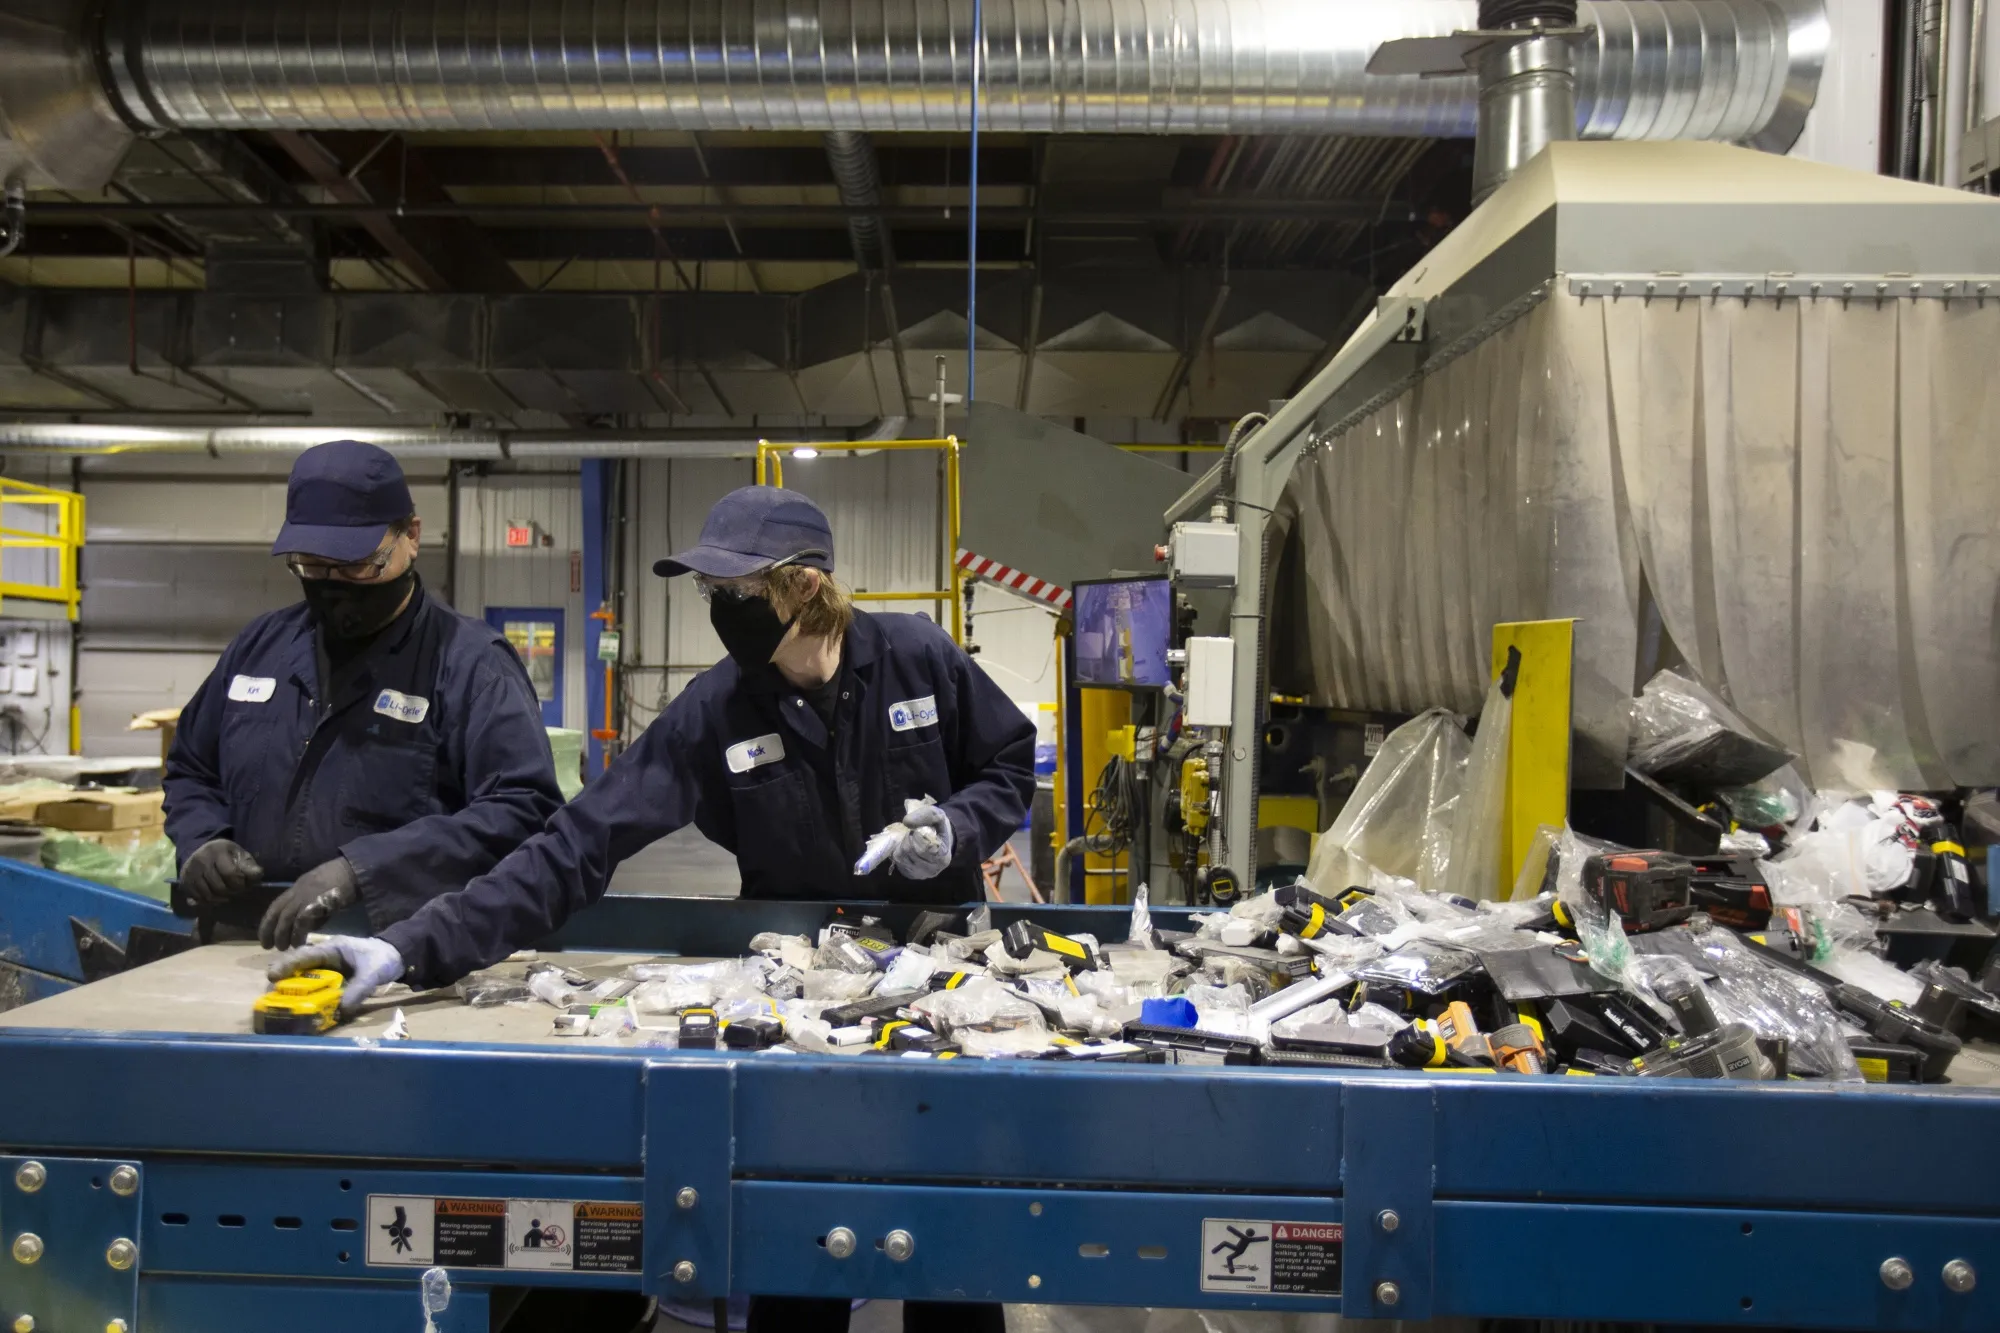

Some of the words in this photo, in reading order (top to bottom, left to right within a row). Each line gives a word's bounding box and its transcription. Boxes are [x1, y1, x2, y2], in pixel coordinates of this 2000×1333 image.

[747, 745, 766, 759] Nick
[832, 927, 860, 937] LITHIU
[1727, 1057, 1750, 1071] RYOBI
[450, 1202, 504, 1213] WARNING
[590, 1206, 643, 1216] WARNING
[1292, 1228, 1342, 1239] DANGER
